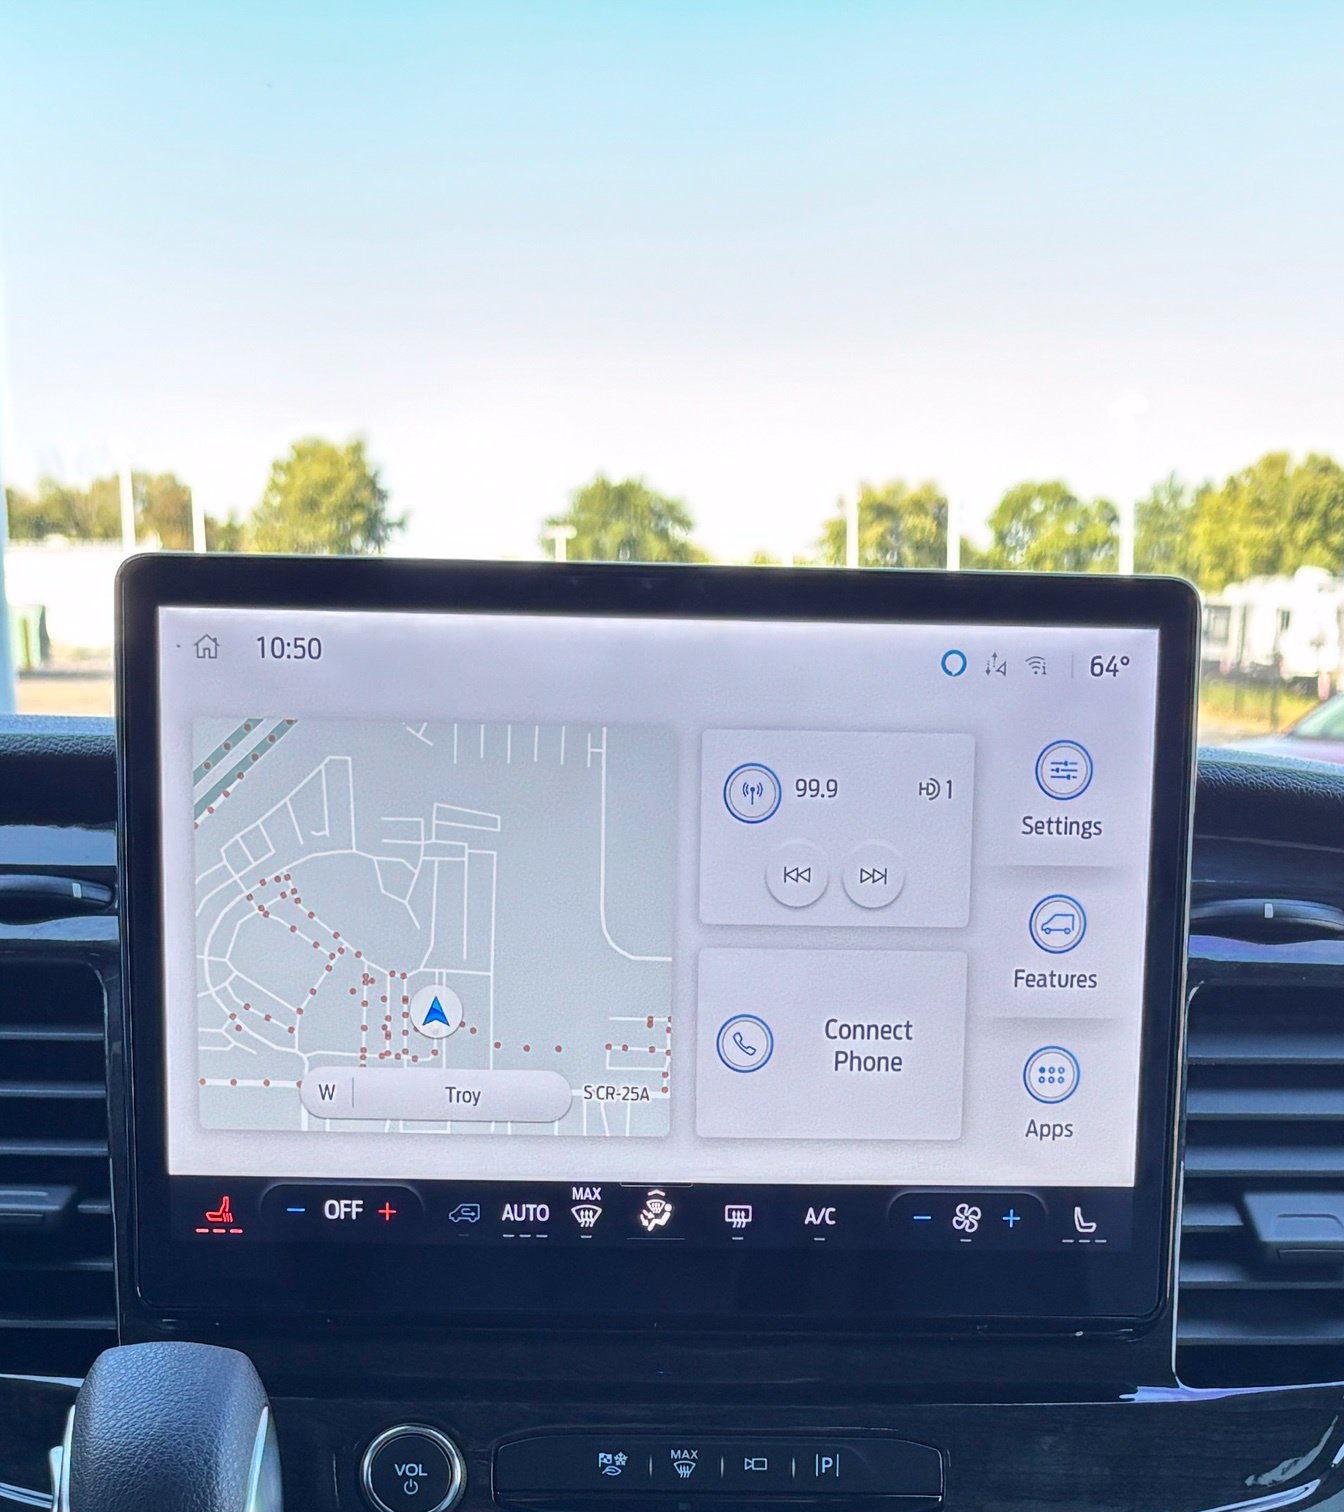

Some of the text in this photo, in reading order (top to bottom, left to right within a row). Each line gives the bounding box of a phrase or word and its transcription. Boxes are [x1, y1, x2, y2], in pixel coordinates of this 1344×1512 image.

[256, 636, 322, 660] 10:50
[795, 778, 838, 799] 99.9
[1021, 815, 1103, 840] Settings
[1014, 968, 1098, 990] Features
[824, 1018, 913, 1041] Connect
[834, 1050, 903, 1073] Phone
[318, 1083, 336, 1101] W
[444, 1086, 481, 1107] Troy
[1025, 1117, 1074, 1142] Apps
[572, 1186, 602, 1201] MAX
[324, 1199, 364, 1220] OFF
[501, 1203, 550, 1222] AUTO
[804, 1206, 837, 1225] A/C
[670, 1449, 698, 1461] MAX
[394, 1463, 428, 1478] VOL
